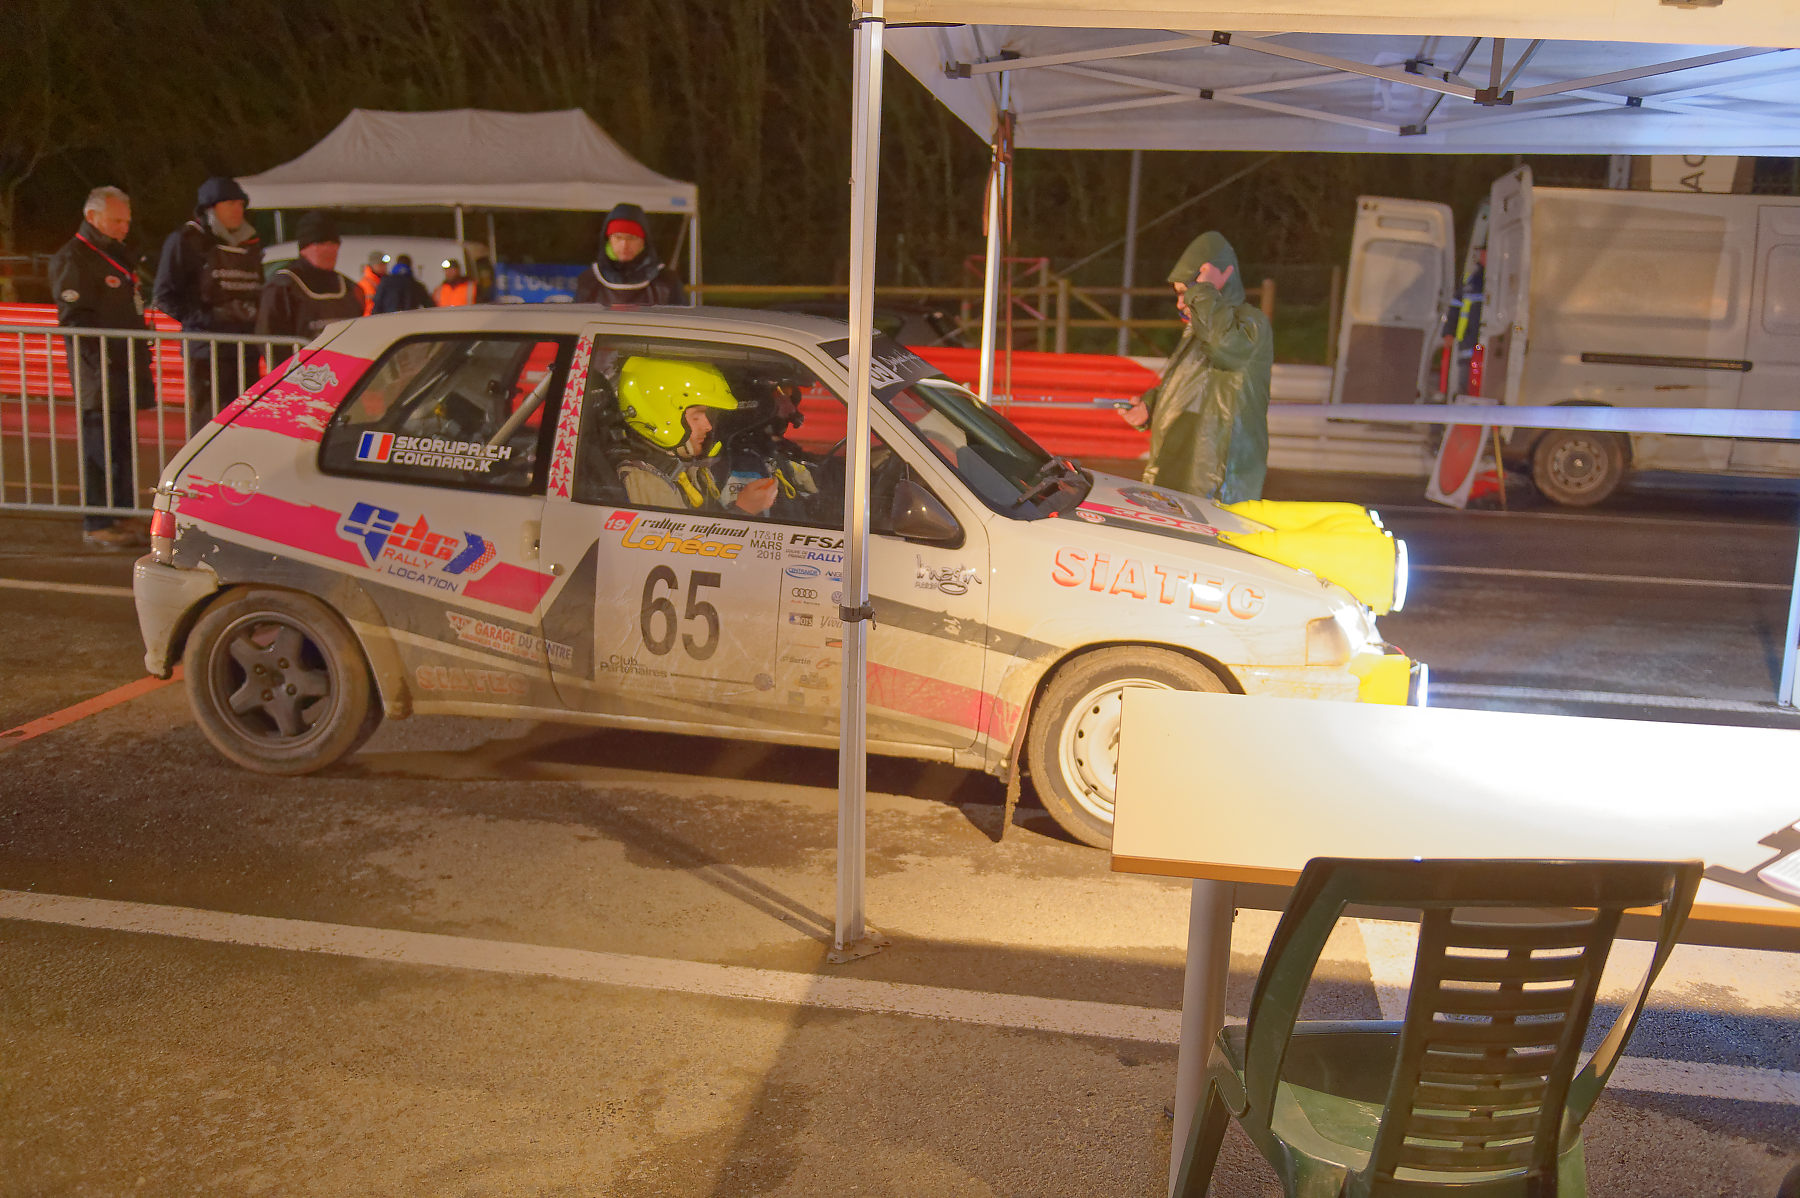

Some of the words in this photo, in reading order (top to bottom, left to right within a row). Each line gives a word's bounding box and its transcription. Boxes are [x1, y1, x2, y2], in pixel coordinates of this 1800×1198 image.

[396, 435, 512, 460] SKORUPA.CH
[393, 451, 492, 472] COIGNARD.K
[641, 517, 687, 535] rallye
[690, 522, 749, 538] national
[622, 517, 743, 560] Lohéac
[750, 539, 782, 551] MARS
[790, 533, 844, 549] FFSA
[383, 547, 434, 569] RALLY
[756, 550, 782, 561] 2018
[807, 551, 843, 563] RALLY
[388, 564, 459, 592] LOCATION
[640, 565, 721, 661] 65
[474, 621, 516, 645] GARAGE
[518, 634, 533, 650] DU
[609, 654, 638, 666] Club
